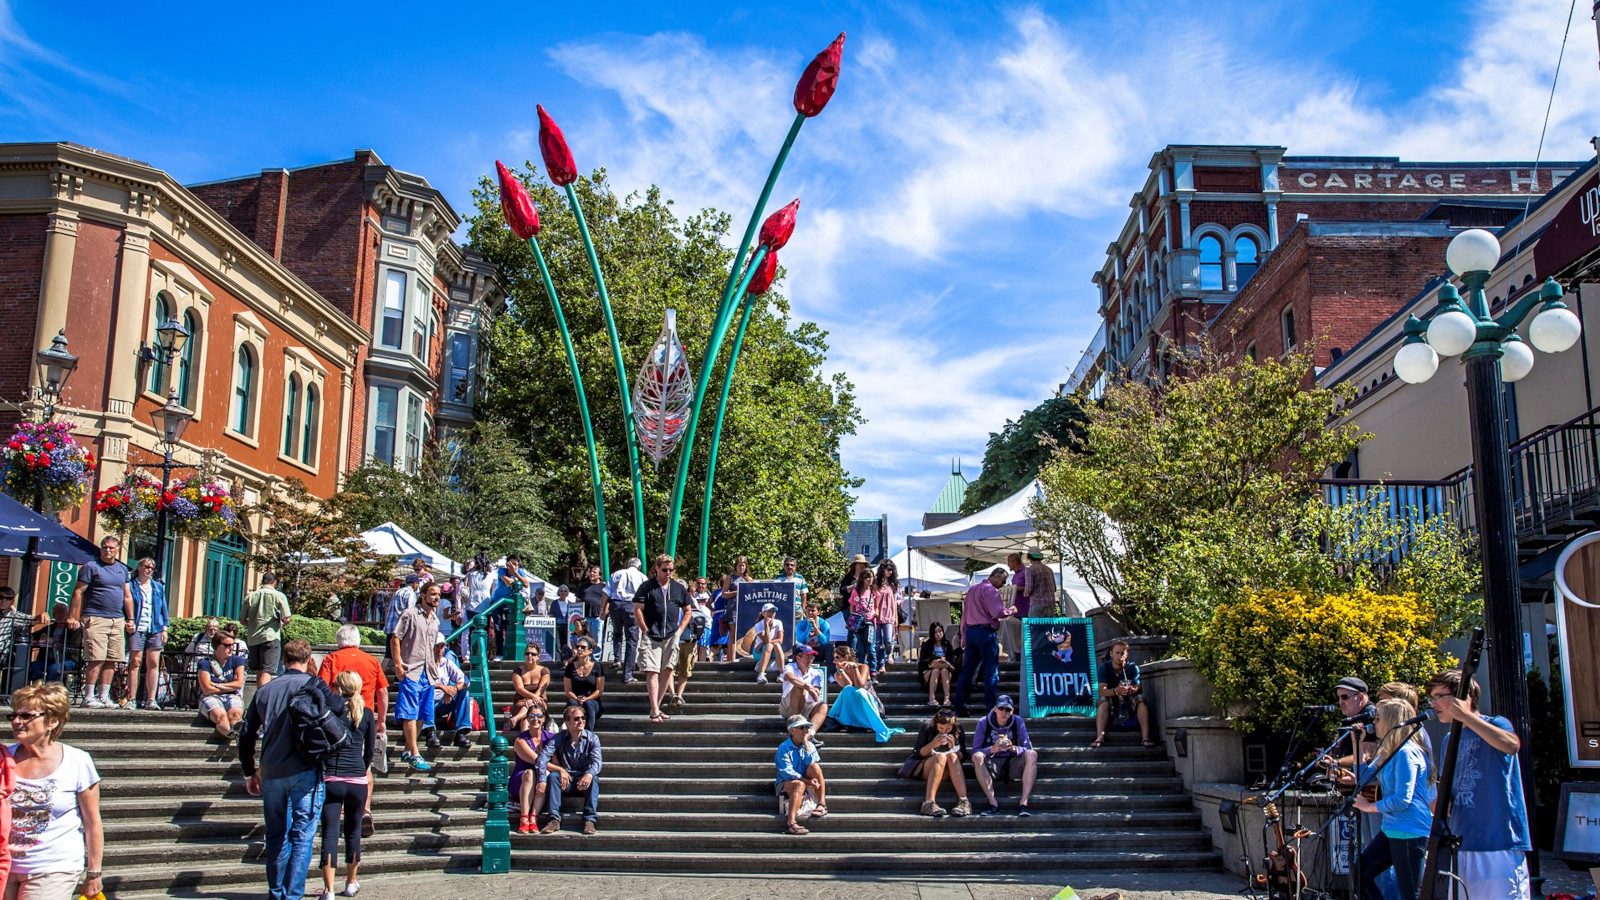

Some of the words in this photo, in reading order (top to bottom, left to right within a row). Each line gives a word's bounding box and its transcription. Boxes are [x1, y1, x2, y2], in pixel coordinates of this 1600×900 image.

[1297, 172, 1466, 188] CARTAGE
[1580, 186, 1600, 237] UP
[744, 590, 788, 602] MARITIME
[1033, 672, 1092, 696] UTOPIA
[1575, 815, 1600, 826] TH
